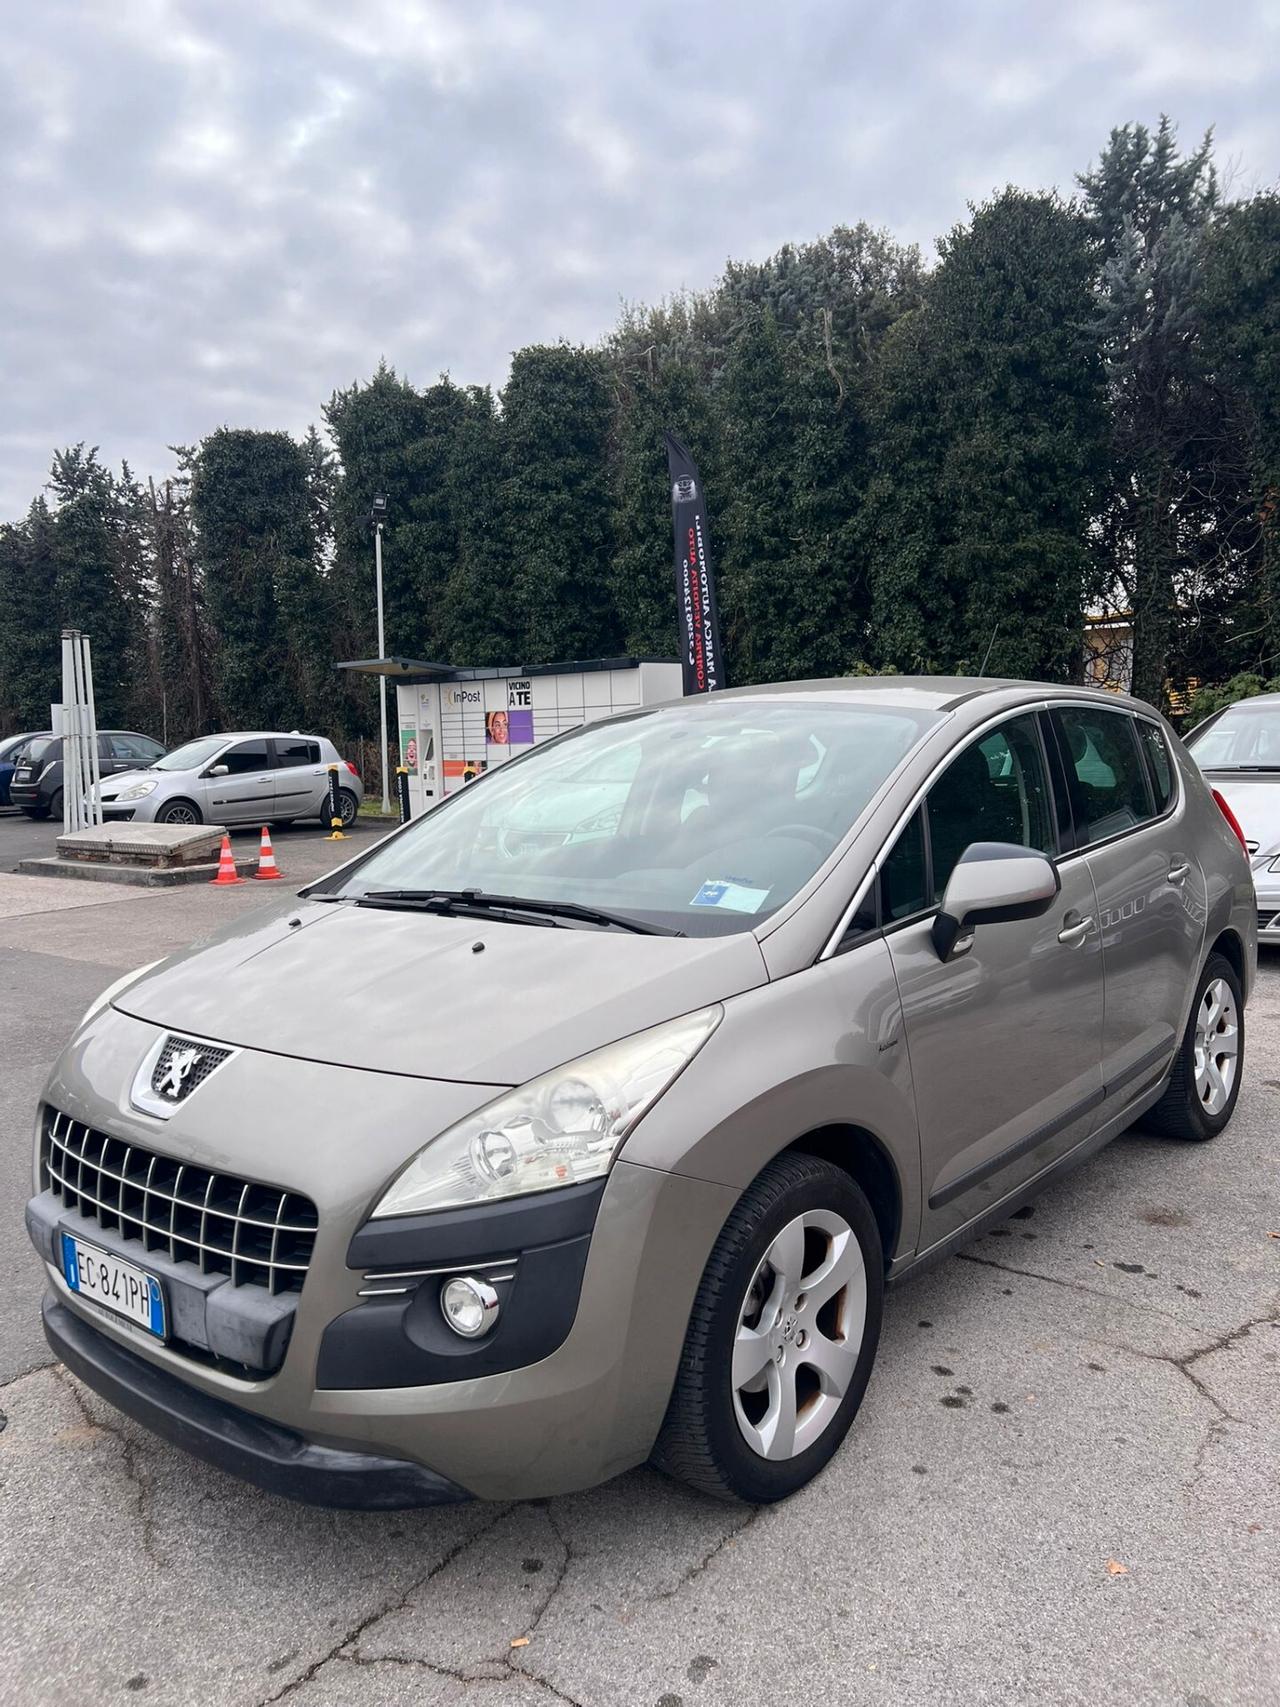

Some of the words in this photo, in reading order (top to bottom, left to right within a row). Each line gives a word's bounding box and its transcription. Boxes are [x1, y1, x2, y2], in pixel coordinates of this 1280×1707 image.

[508, 681, 531, 690] VICINO
[453, 690, 481, 703] InPost
[509, 691, 516, 706] A
[516, 690, 531, 706] TE
